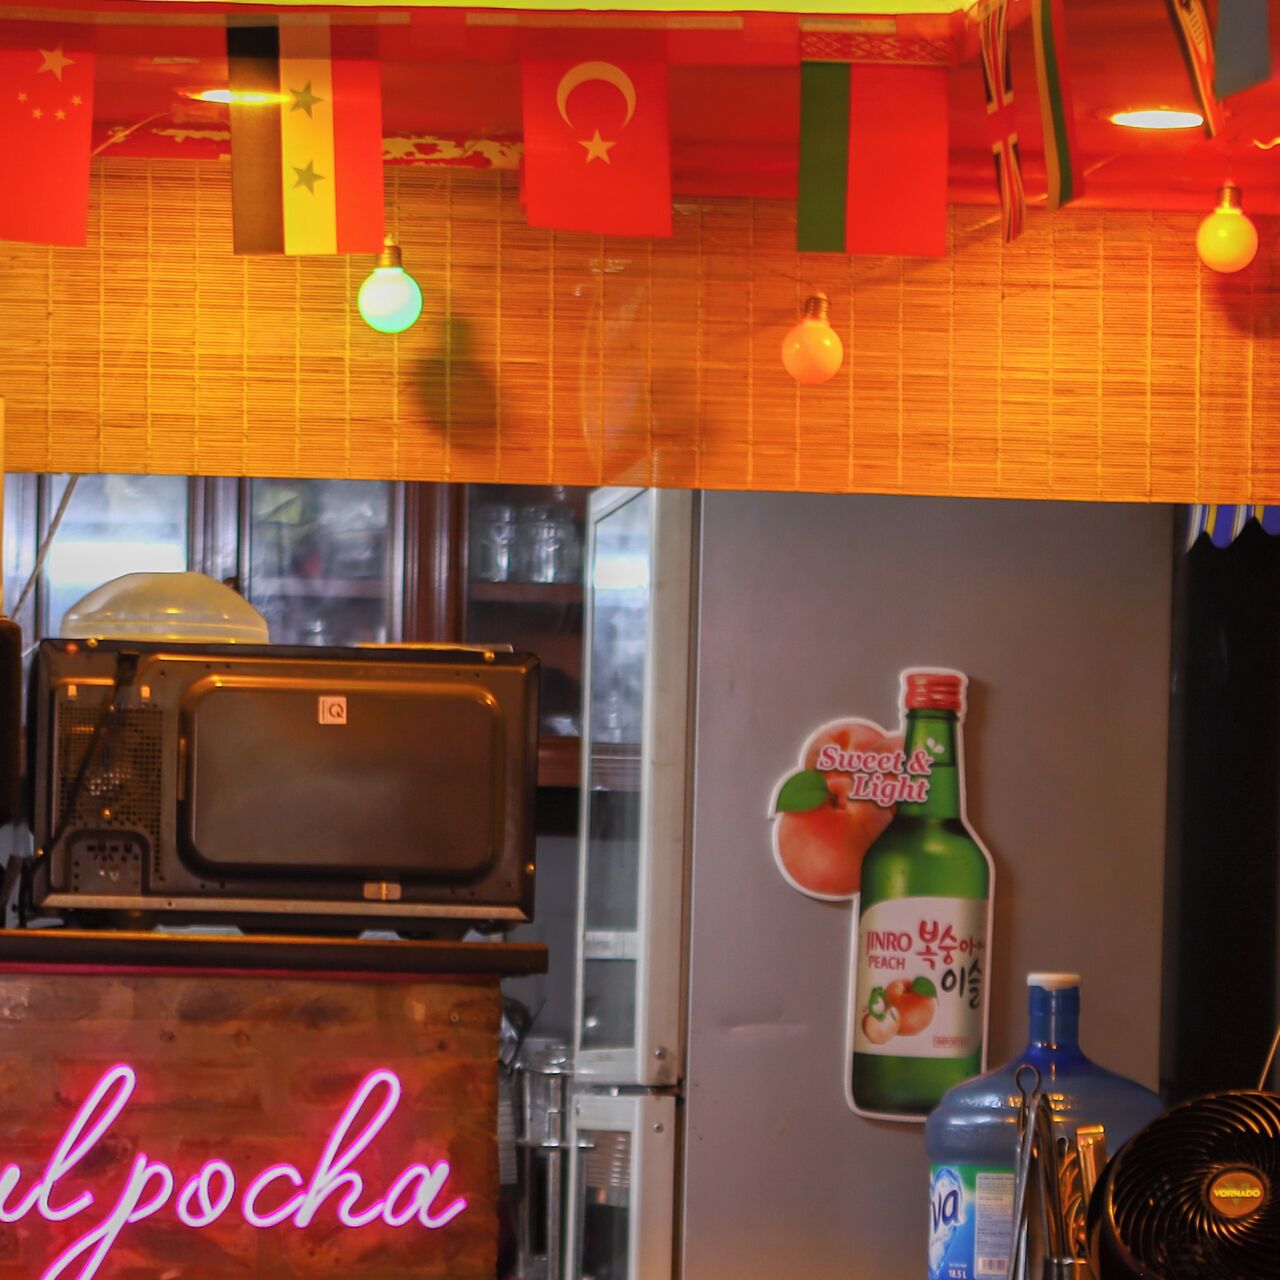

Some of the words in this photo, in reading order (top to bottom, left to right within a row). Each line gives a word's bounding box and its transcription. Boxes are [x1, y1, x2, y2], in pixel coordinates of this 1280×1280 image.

[817, 745, 907, 773] Sweet
[907, 749, 934, 775] &
[849, 773, 930, 807] Light
[866, 931, 913, 955] JINRO
[868, 956, 906, 970] PEACH
